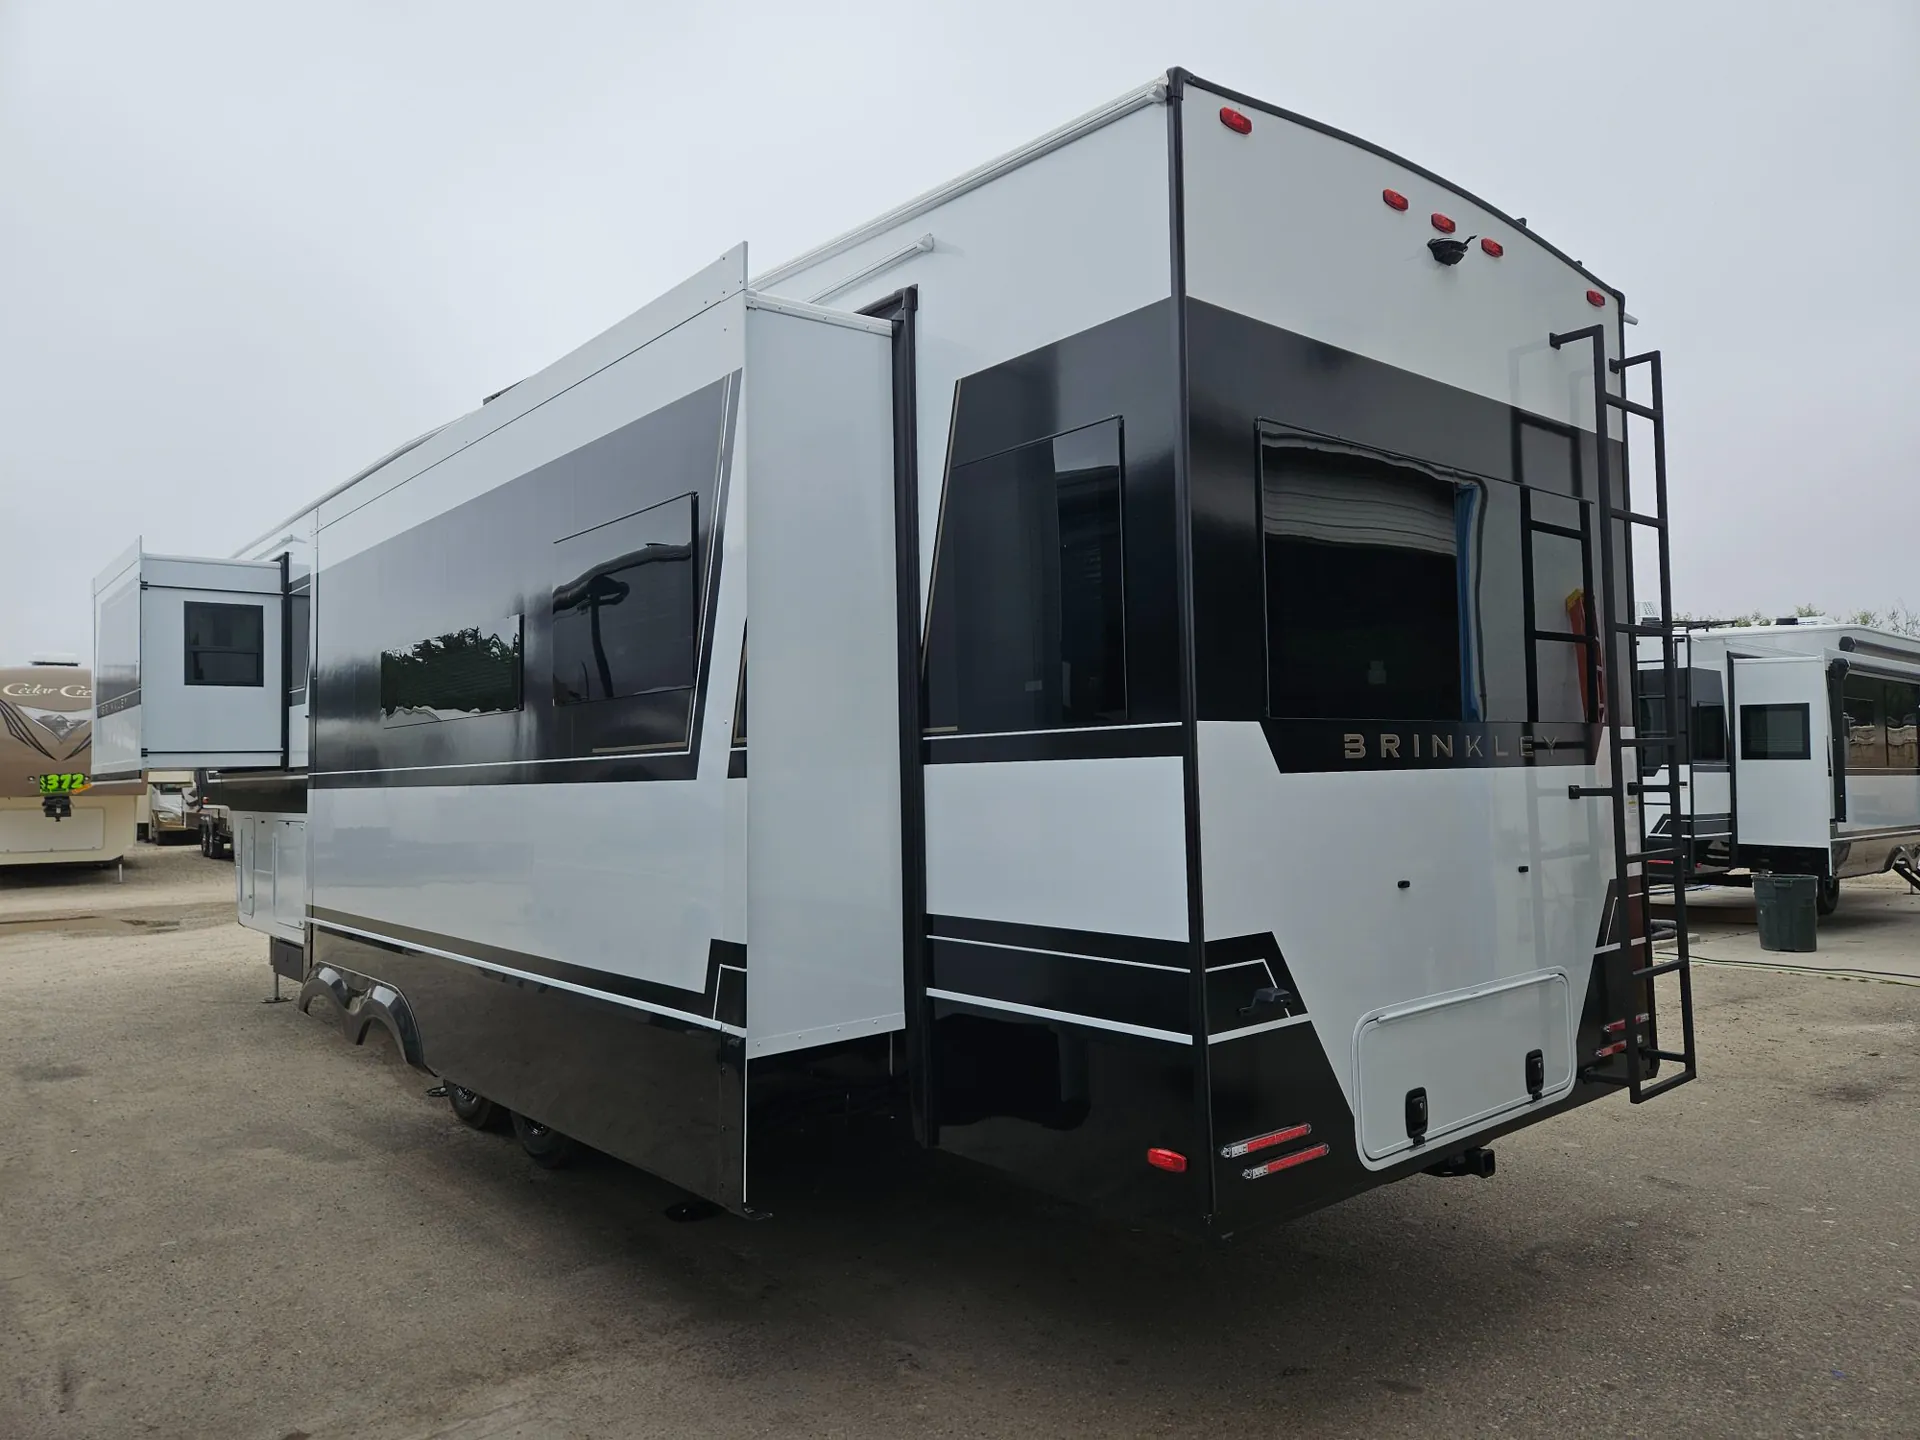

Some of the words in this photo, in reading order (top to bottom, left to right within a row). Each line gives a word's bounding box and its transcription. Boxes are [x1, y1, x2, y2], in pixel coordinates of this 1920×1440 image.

[3, 682, 57, 697] Cedar
[60, 684, 91, 698] Cre
[1343, 733, 1559, 759] BRINKLEY
